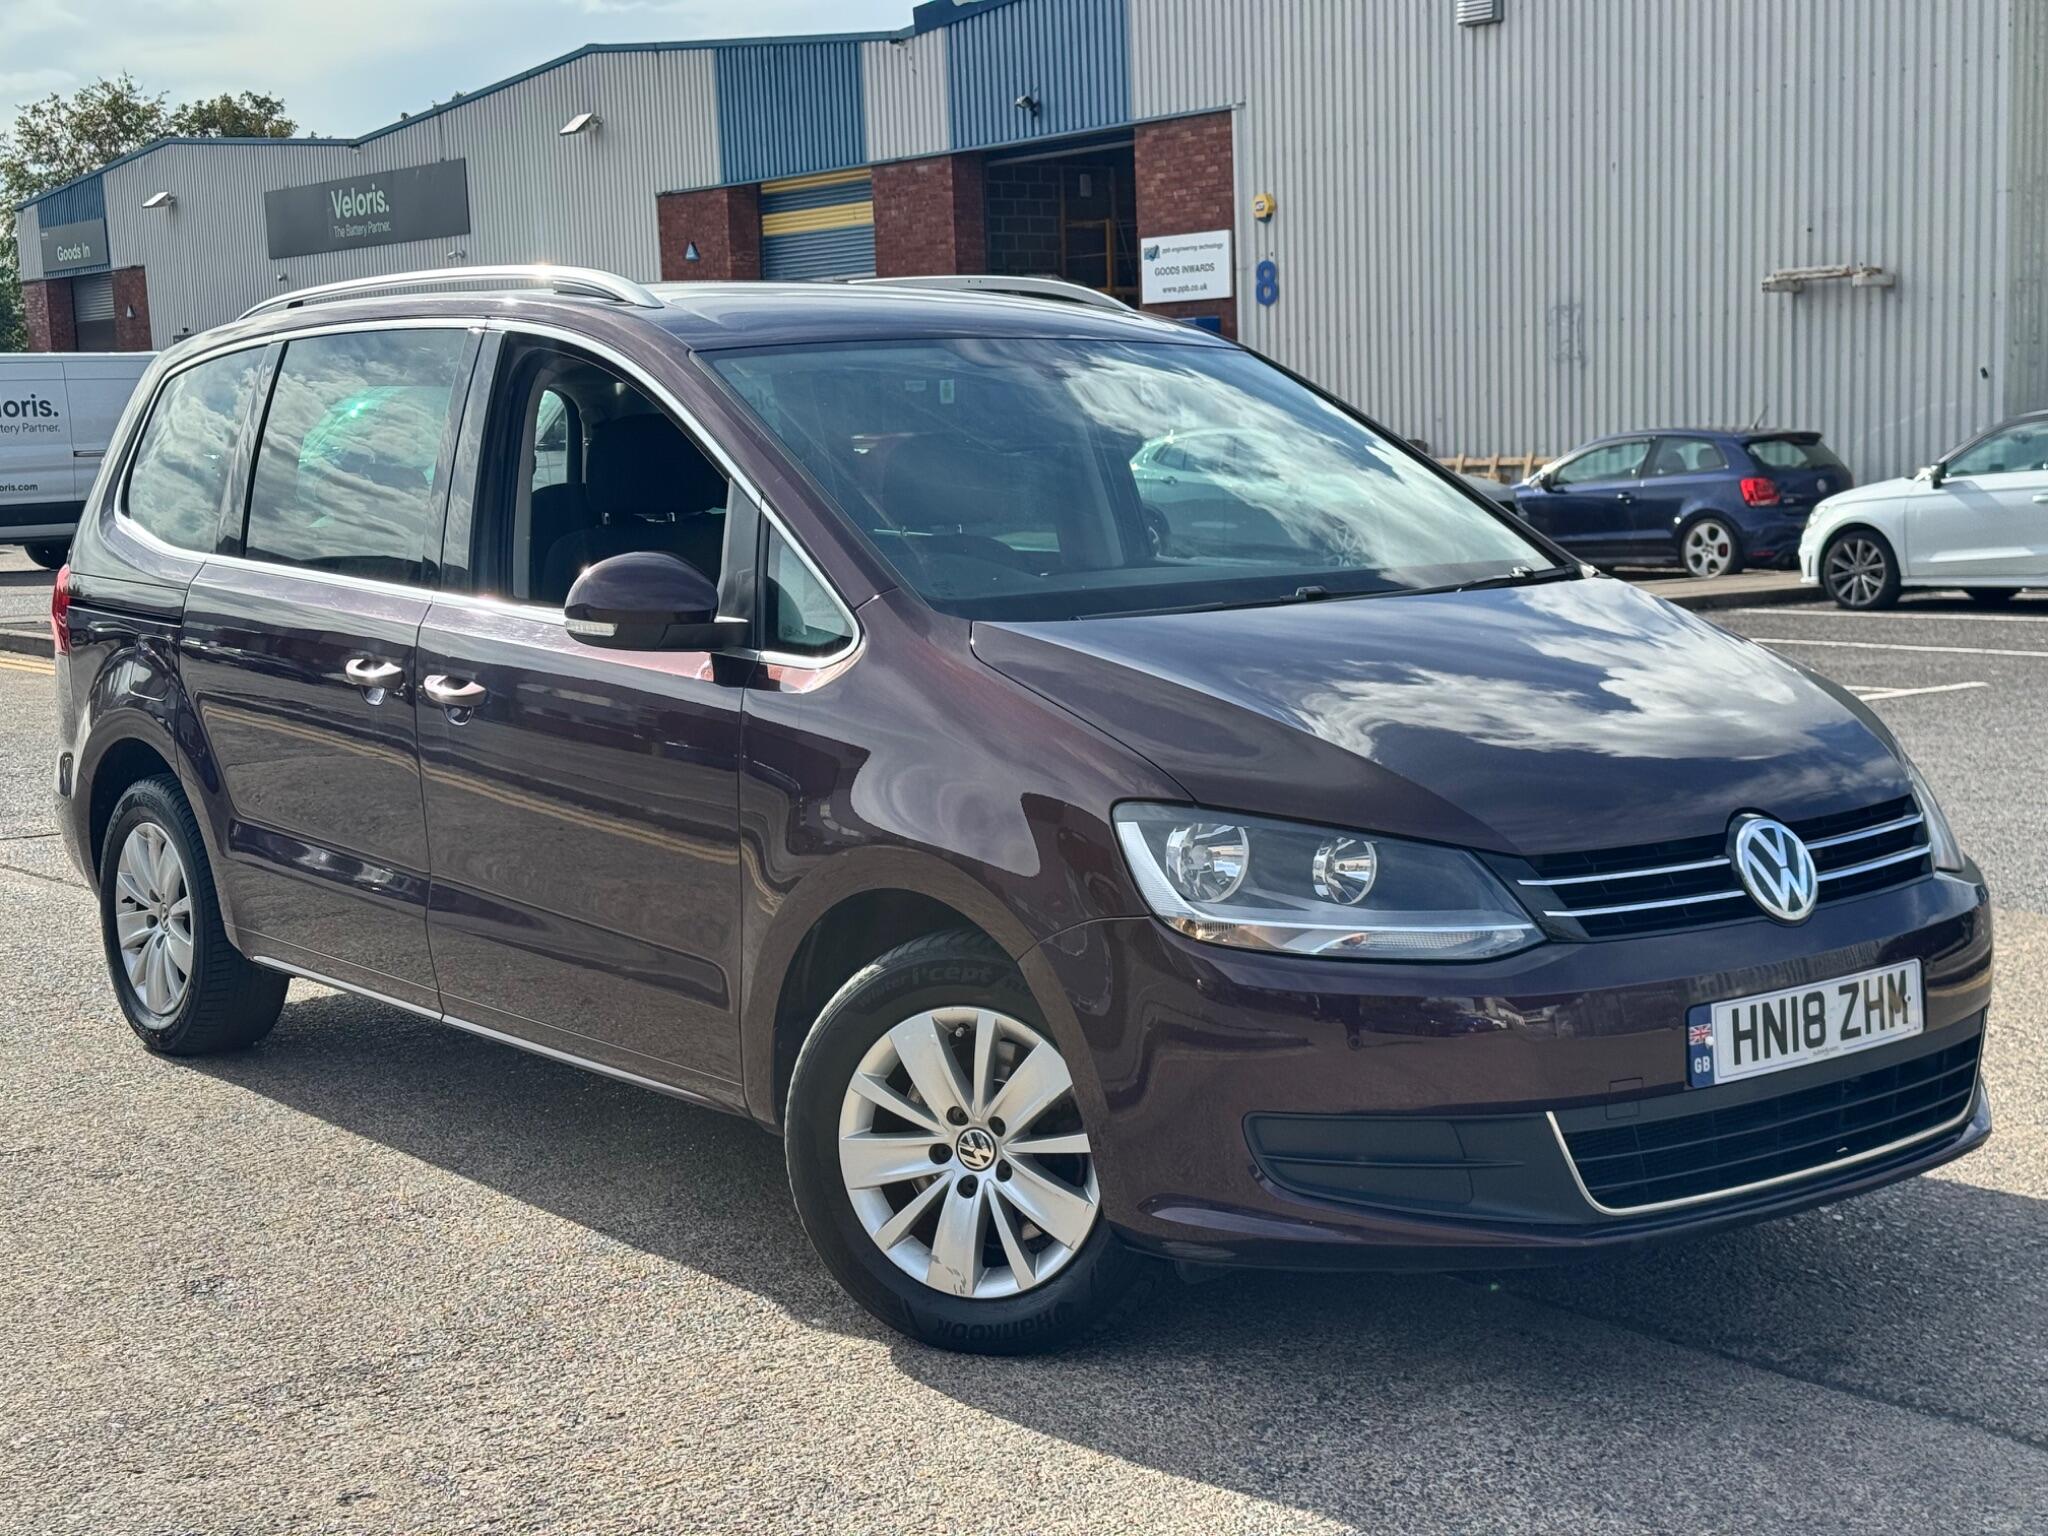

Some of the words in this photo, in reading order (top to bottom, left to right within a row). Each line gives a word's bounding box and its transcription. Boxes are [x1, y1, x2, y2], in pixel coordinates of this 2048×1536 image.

[331, 183, 390, 219] Veloris.
[333, 225, 345, 238] The
[57, 243, 81, 262] Goods
[82, 242, 91, 258] In
[1154, 266, 1180, 276] GOODS
[1182, 262, 1215, 274] INWARDS
[1256, 260, 1278, 306] 8
[0, 393, 59, 418] oris.
[22, 422, 60, 433] Partner.
[1731, 990, 1827, 1066] HN18
[1838, 969, 1910, 1041] ZHM
[1694, 1055, 1711, 1074] GB
